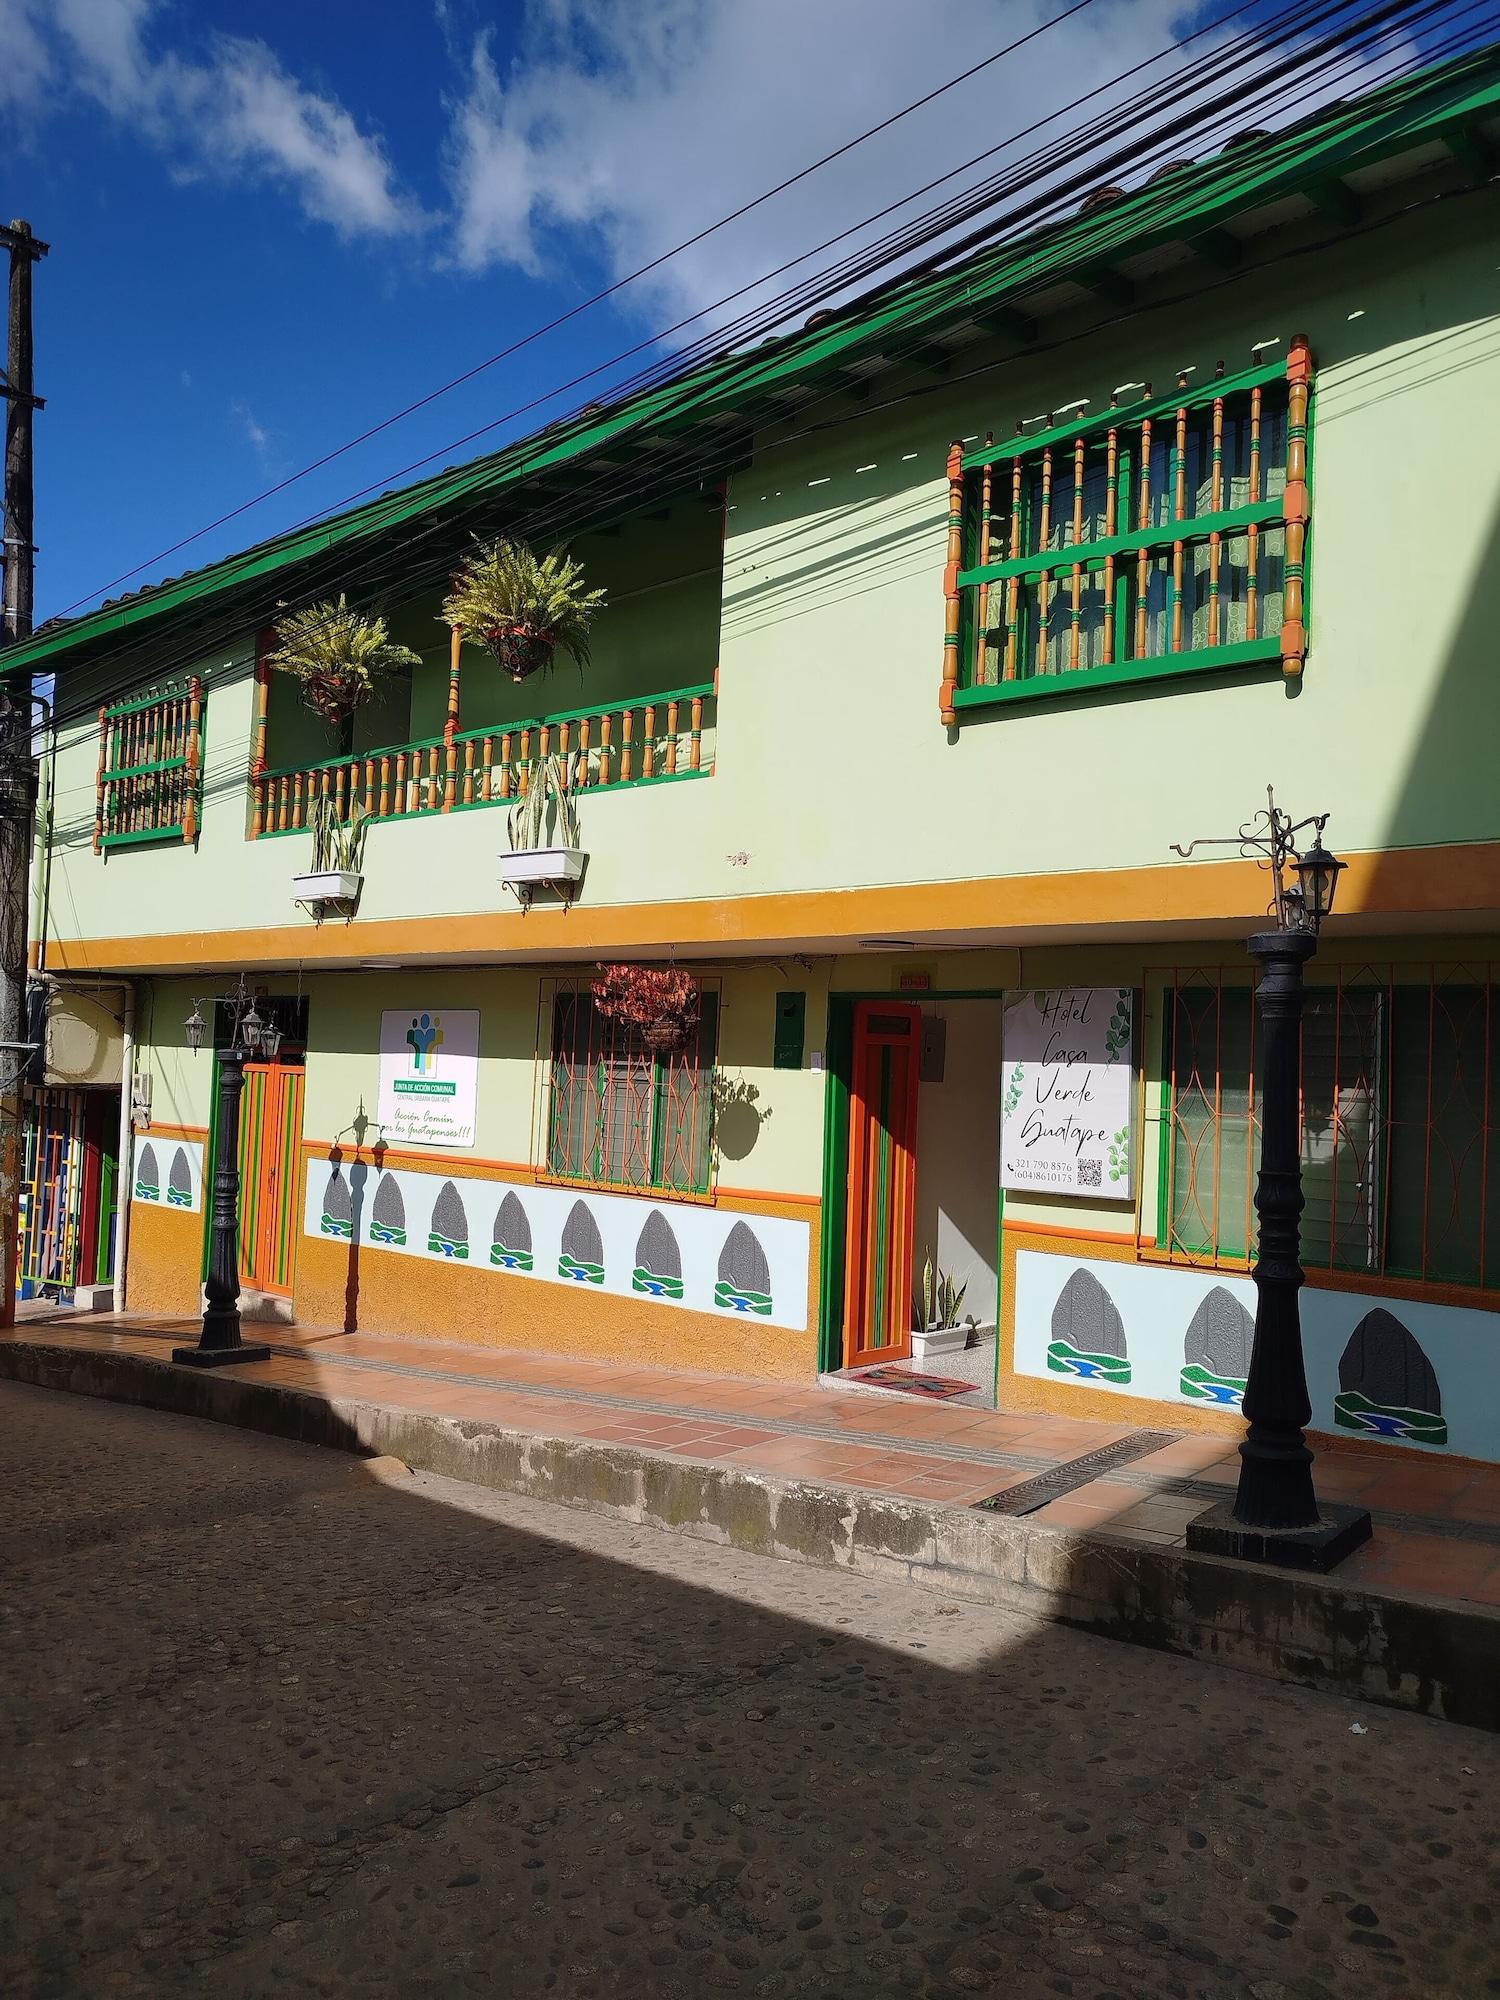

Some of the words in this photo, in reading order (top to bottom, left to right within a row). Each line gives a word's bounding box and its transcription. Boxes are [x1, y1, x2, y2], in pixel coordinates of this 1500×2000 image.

[1041, 990, 1092, 1028] Hotel
[1042, 1031, 1088, 1068] Casa
[1036, 1067, 1095, 1107] Verde
[1020, 1108, 1109, 1157] Guatape
[1014, 1170, 1073, 1183] (604)8610175
[1015, 1158, 1030, 1169] 321
[1033, 1161, 1048, 1170] 790
[1050, 1161, 1073, 1172] 8576
